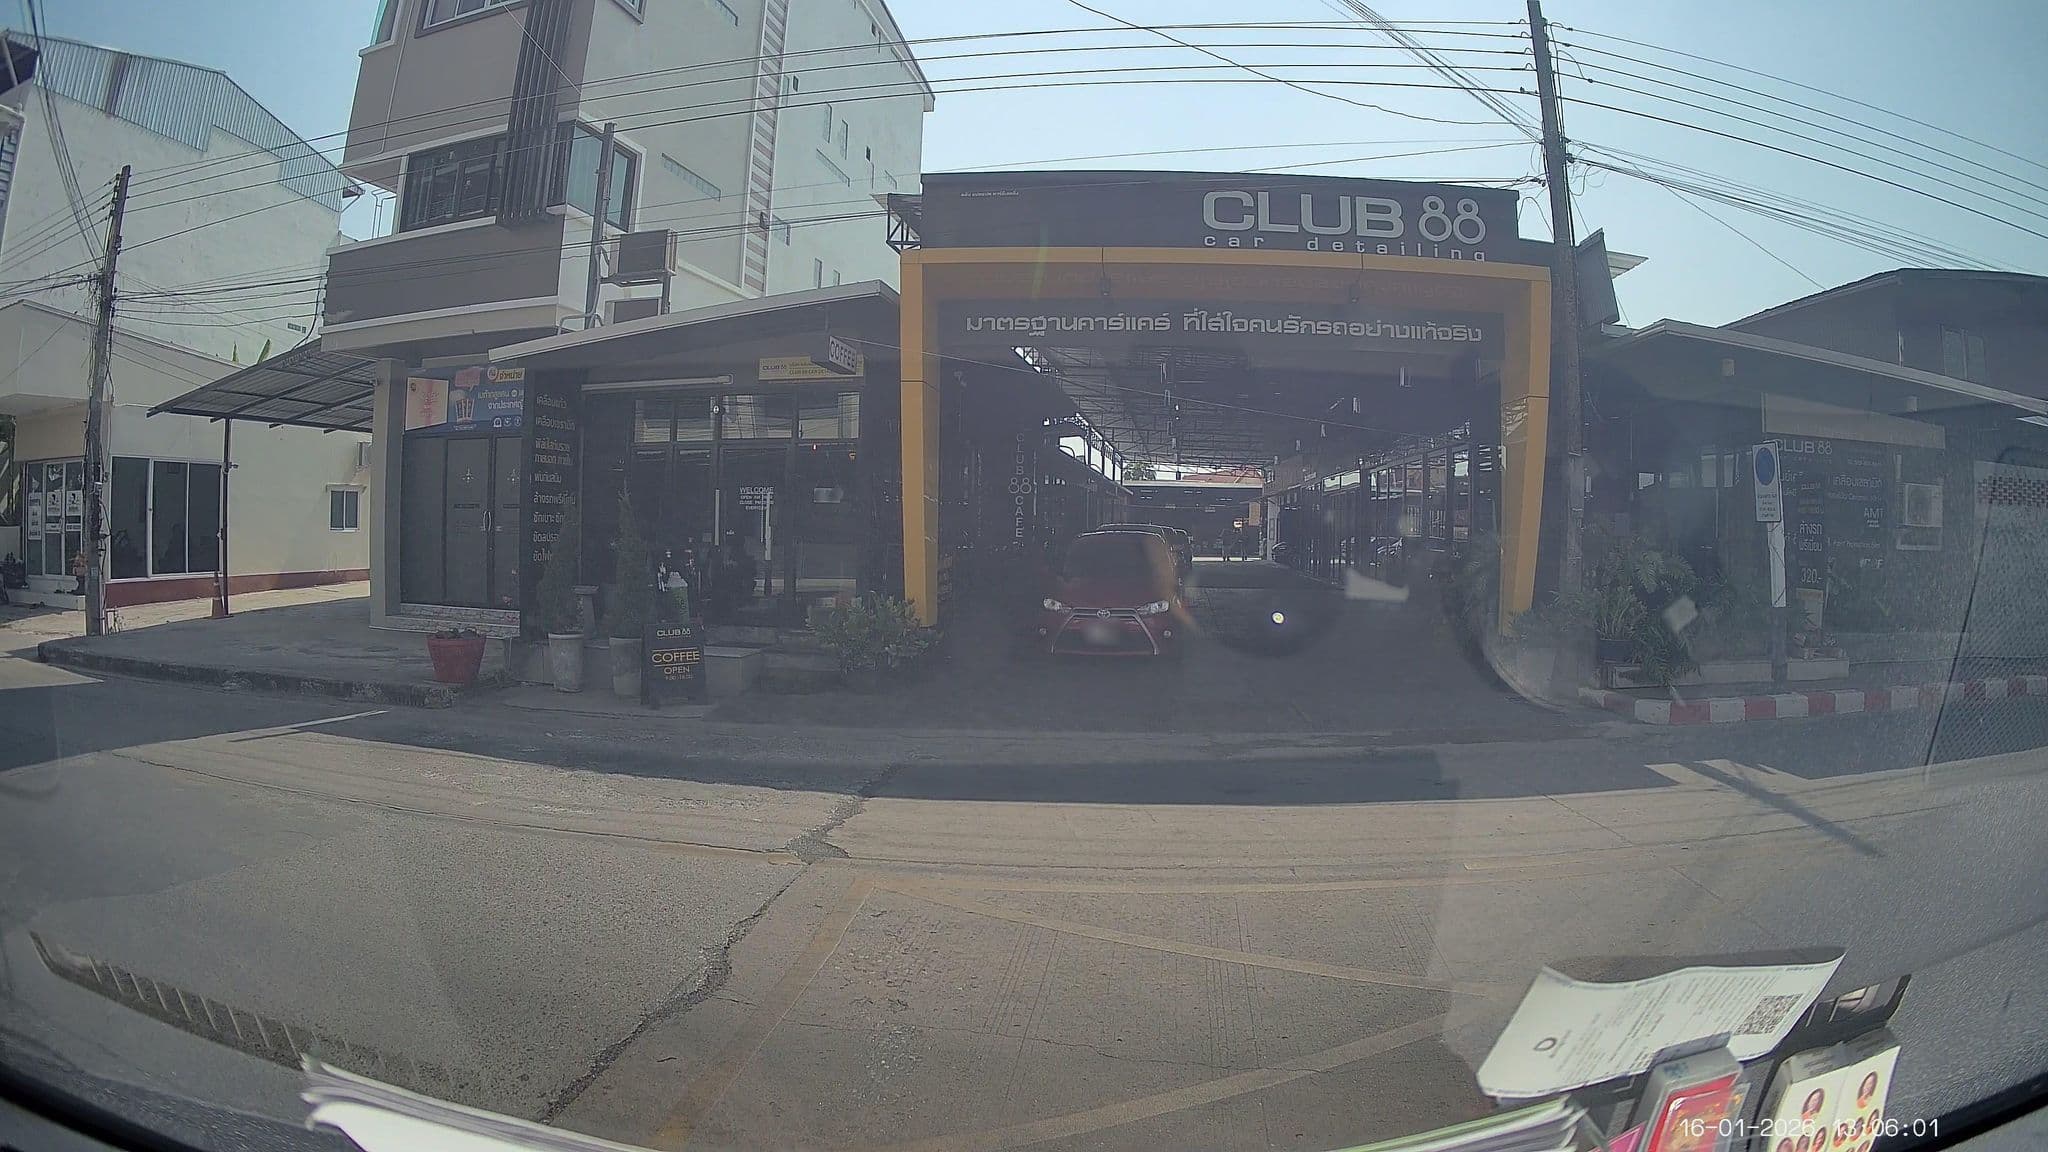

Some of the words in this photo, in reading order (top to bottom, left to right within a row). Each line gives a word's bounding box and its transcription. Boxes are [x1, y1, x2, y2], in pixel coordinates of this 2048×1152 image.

[1202, 190, 1405, 239] CLUB
[1418, 195, 1487, 245] 88
[1202, 235, 1265, 248] car
[1306, 237, 1486, 262] detailing
[966, 312, 1171, 337] มาตรฐานคาร์แคร์
[1183, 307, 1483, 342] ที่ใส่ใจคนรักรถอย่างแท้จริง
[829, 340, 857, 370] COFFEE
[1016, 433, 1025, 475] CLUB
[1009, 477, 1032, 494] 88
[1015, 495, 1025, 538] CAFE
[652, 651, 700, 663] COFFEE
[664, 667, 689, 675] OPEN
